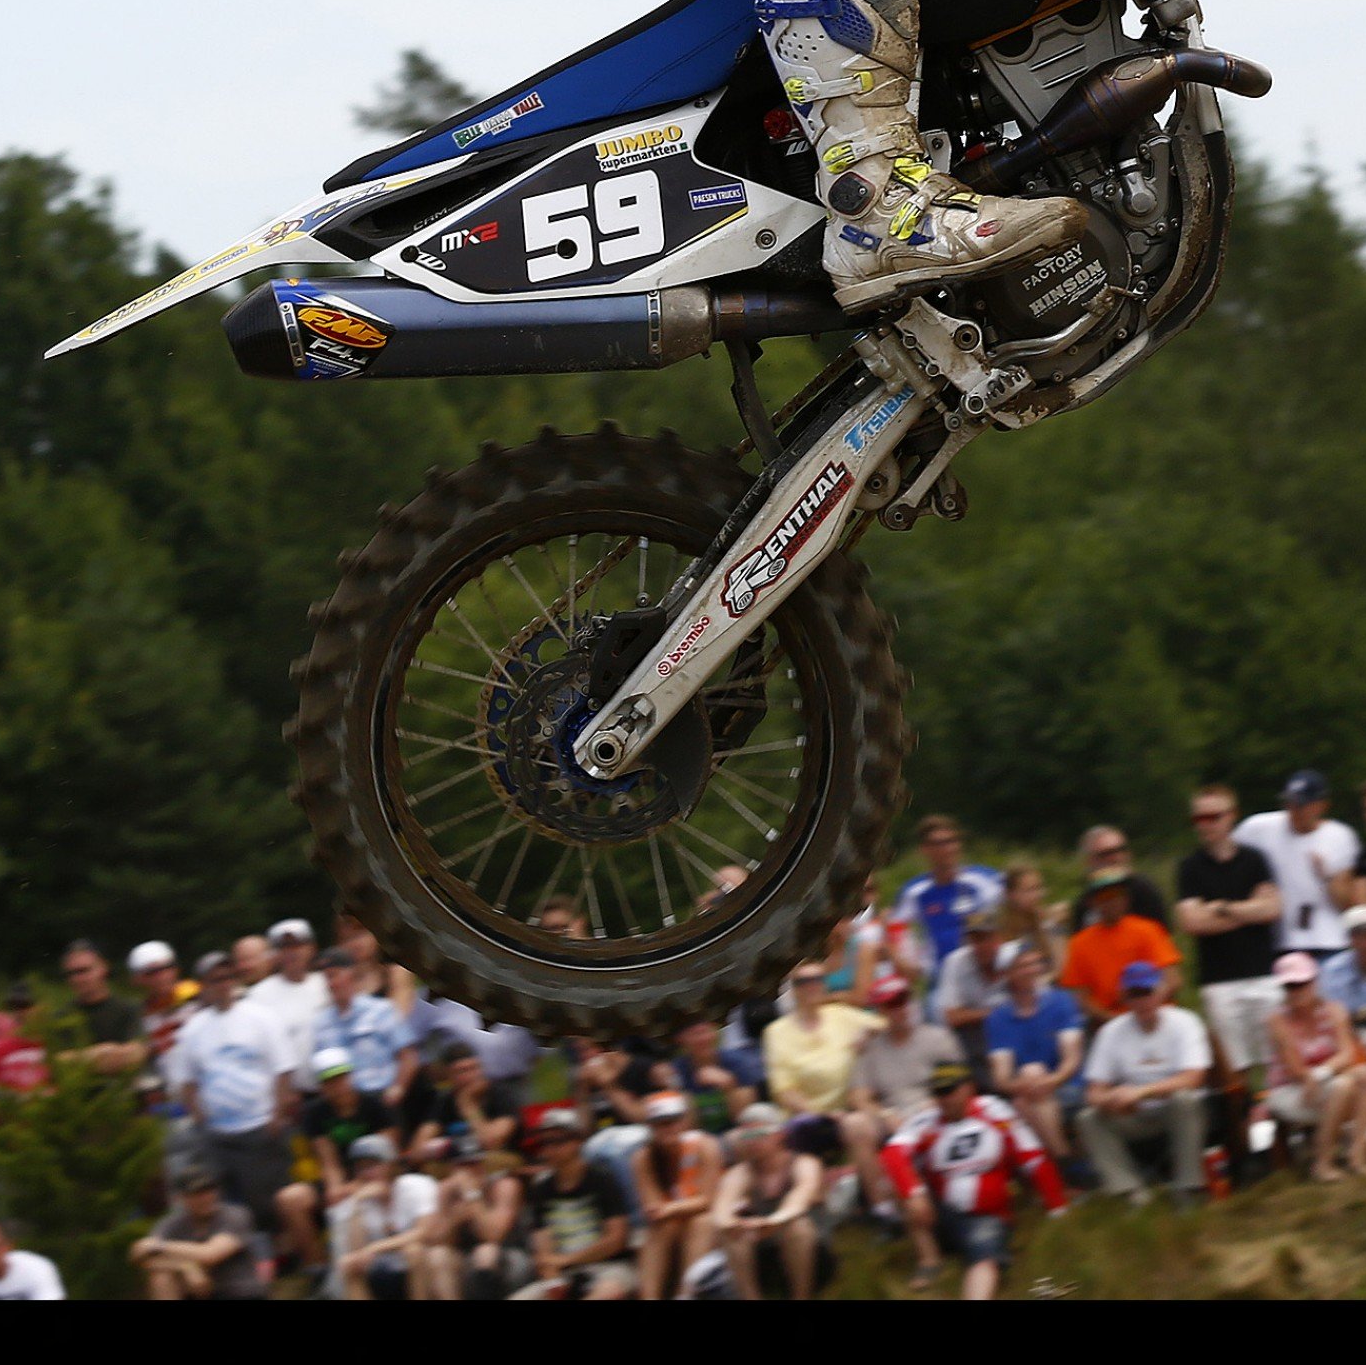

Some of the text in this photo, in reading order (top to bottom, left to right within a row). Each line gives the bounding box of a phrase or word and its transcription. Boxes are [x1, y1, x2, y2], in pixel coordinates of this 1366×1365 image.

[512, 93, 542, 116] VALLE
[596, 125, 684, 159] JUMBO
[601, 142, 678, 170] supermarkten
[693, 188, 742, 204] PAESEN TRUCKS
[441, 221, 499, 253] MX2
[520, 168, 666, 284] 59
[1021, 243, 1083, 291] FACTORY
[1029, 259, 1104, 317] HINSON
[667, 616, 710, 663] brembo
